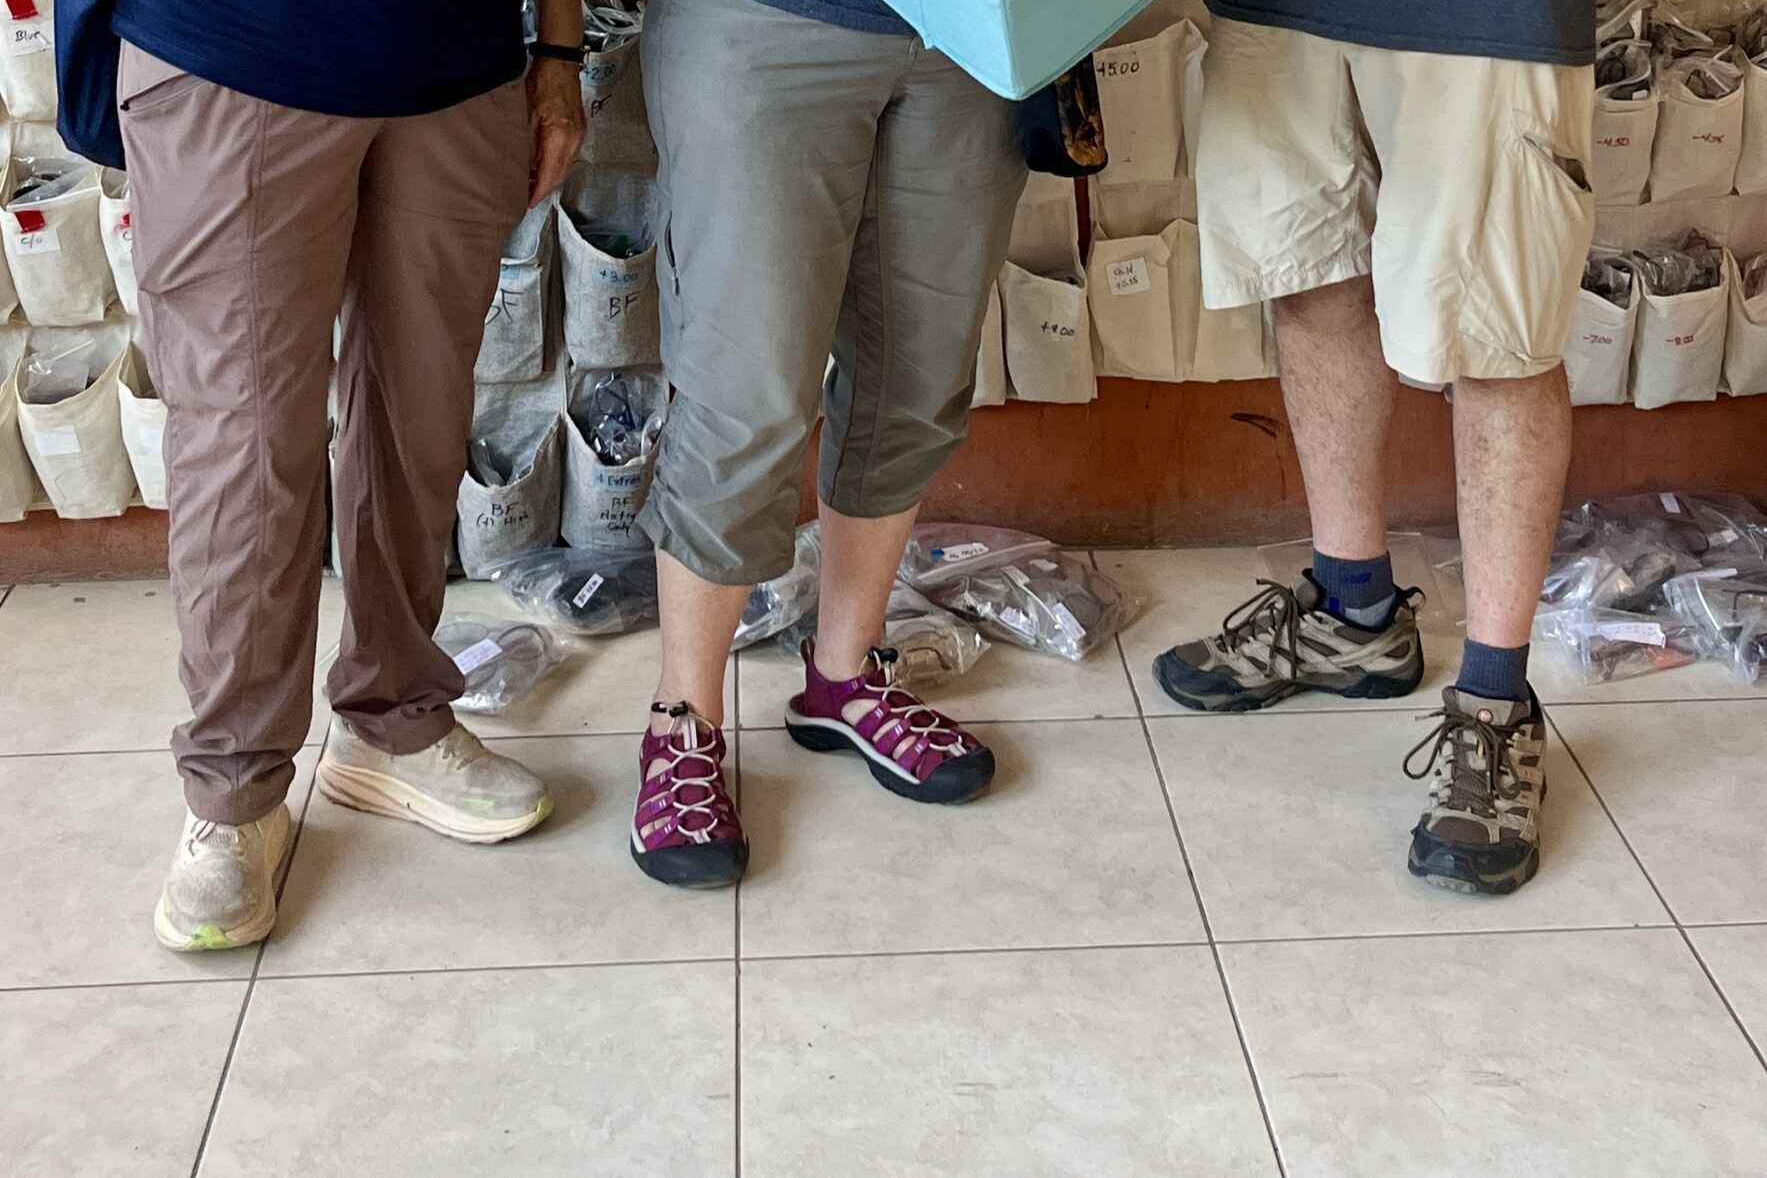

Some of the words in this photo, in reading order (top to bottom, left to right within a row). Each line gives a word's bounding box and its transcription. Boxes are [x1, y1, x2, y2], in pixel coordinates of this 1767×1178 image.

[14, 29, 41, 43] Blue
[608, 290, 641, 322] BF
[490, 502, 519, 516] BF
